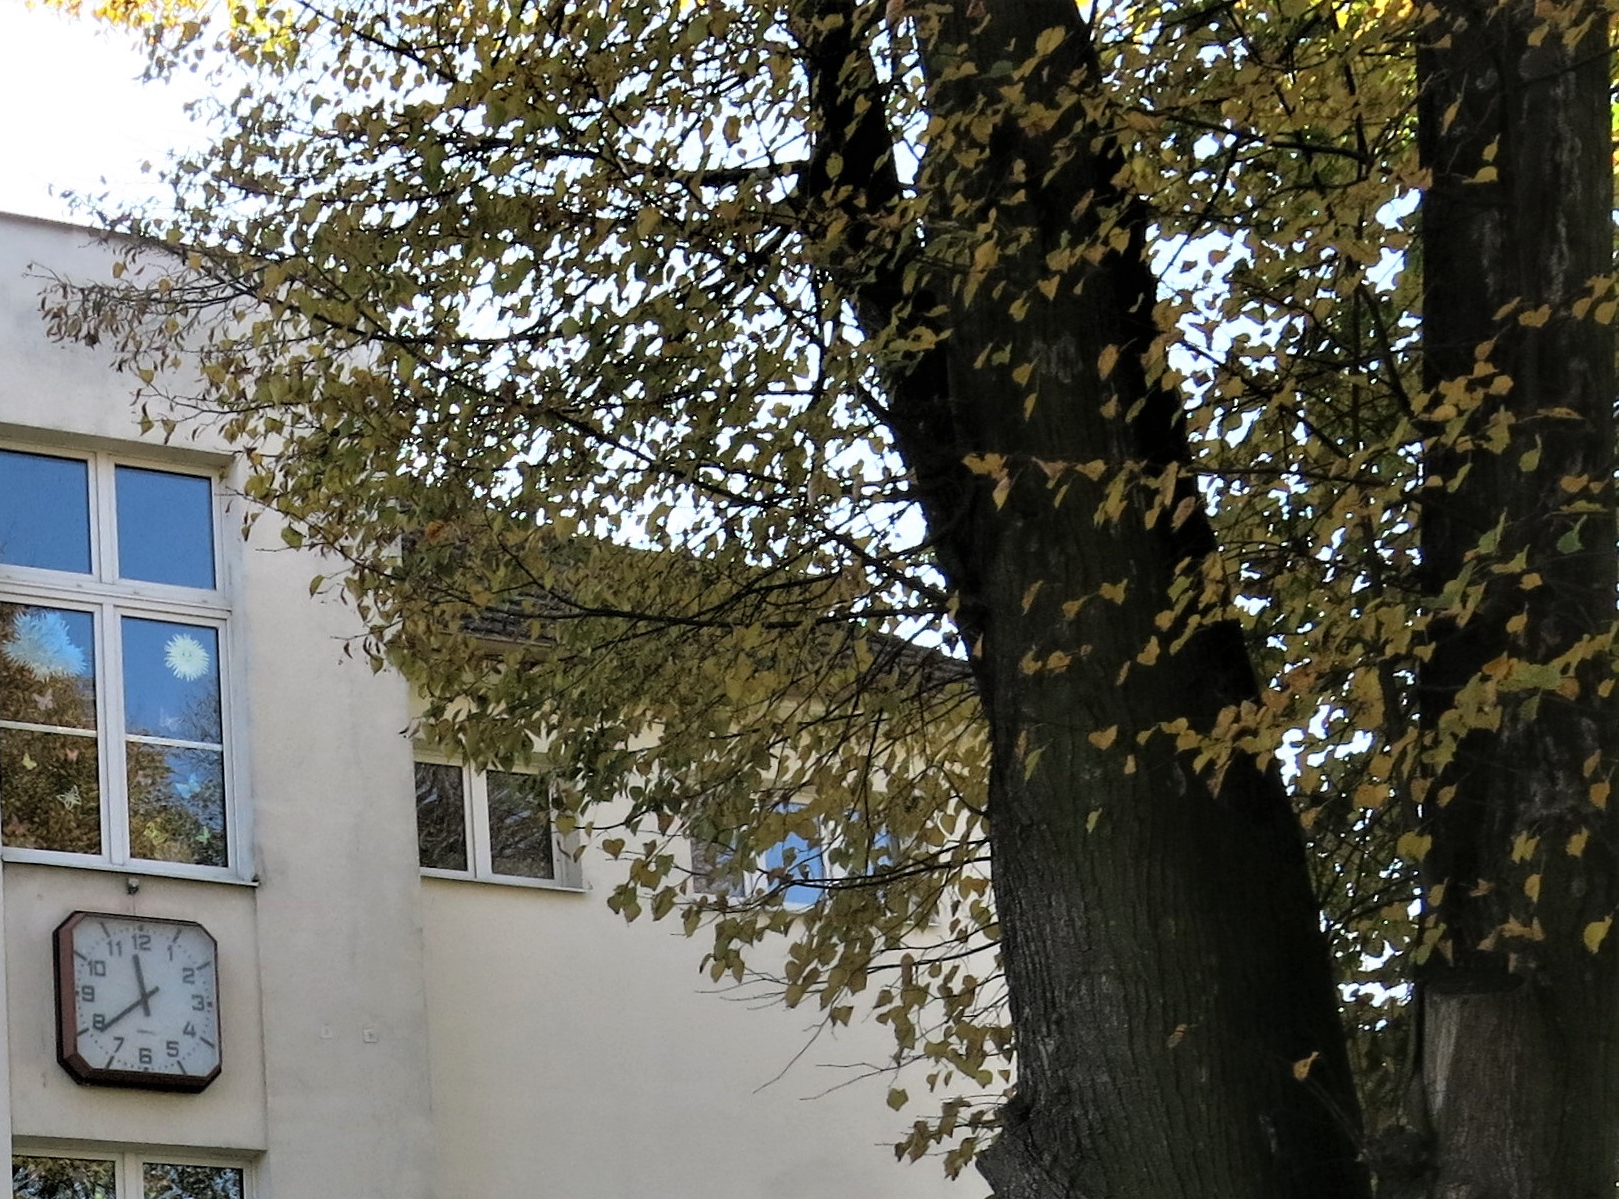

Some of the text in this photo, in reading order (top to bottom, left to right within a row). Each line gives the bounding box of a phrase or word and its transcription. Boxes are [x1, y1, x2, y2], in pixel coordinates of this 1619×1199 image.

[107, 940, 122, 957] 11
[132, 934, 152, 951] 12
[167, 945, 173, 961] 1
[87, 960, 106, 977] 10
[182, 968, 195, 984] 2
[82, 985, 95, 1002] 9
[192, 995, 205, 1011] 3
[92, 1013, 106, 1030] 8
[183, 1022, 196, 1038] 4
[113, 1037, 125, 1053] 7
[166, 1041, 179, 1057] 5
[139, 1048, 152, 1064] 6
